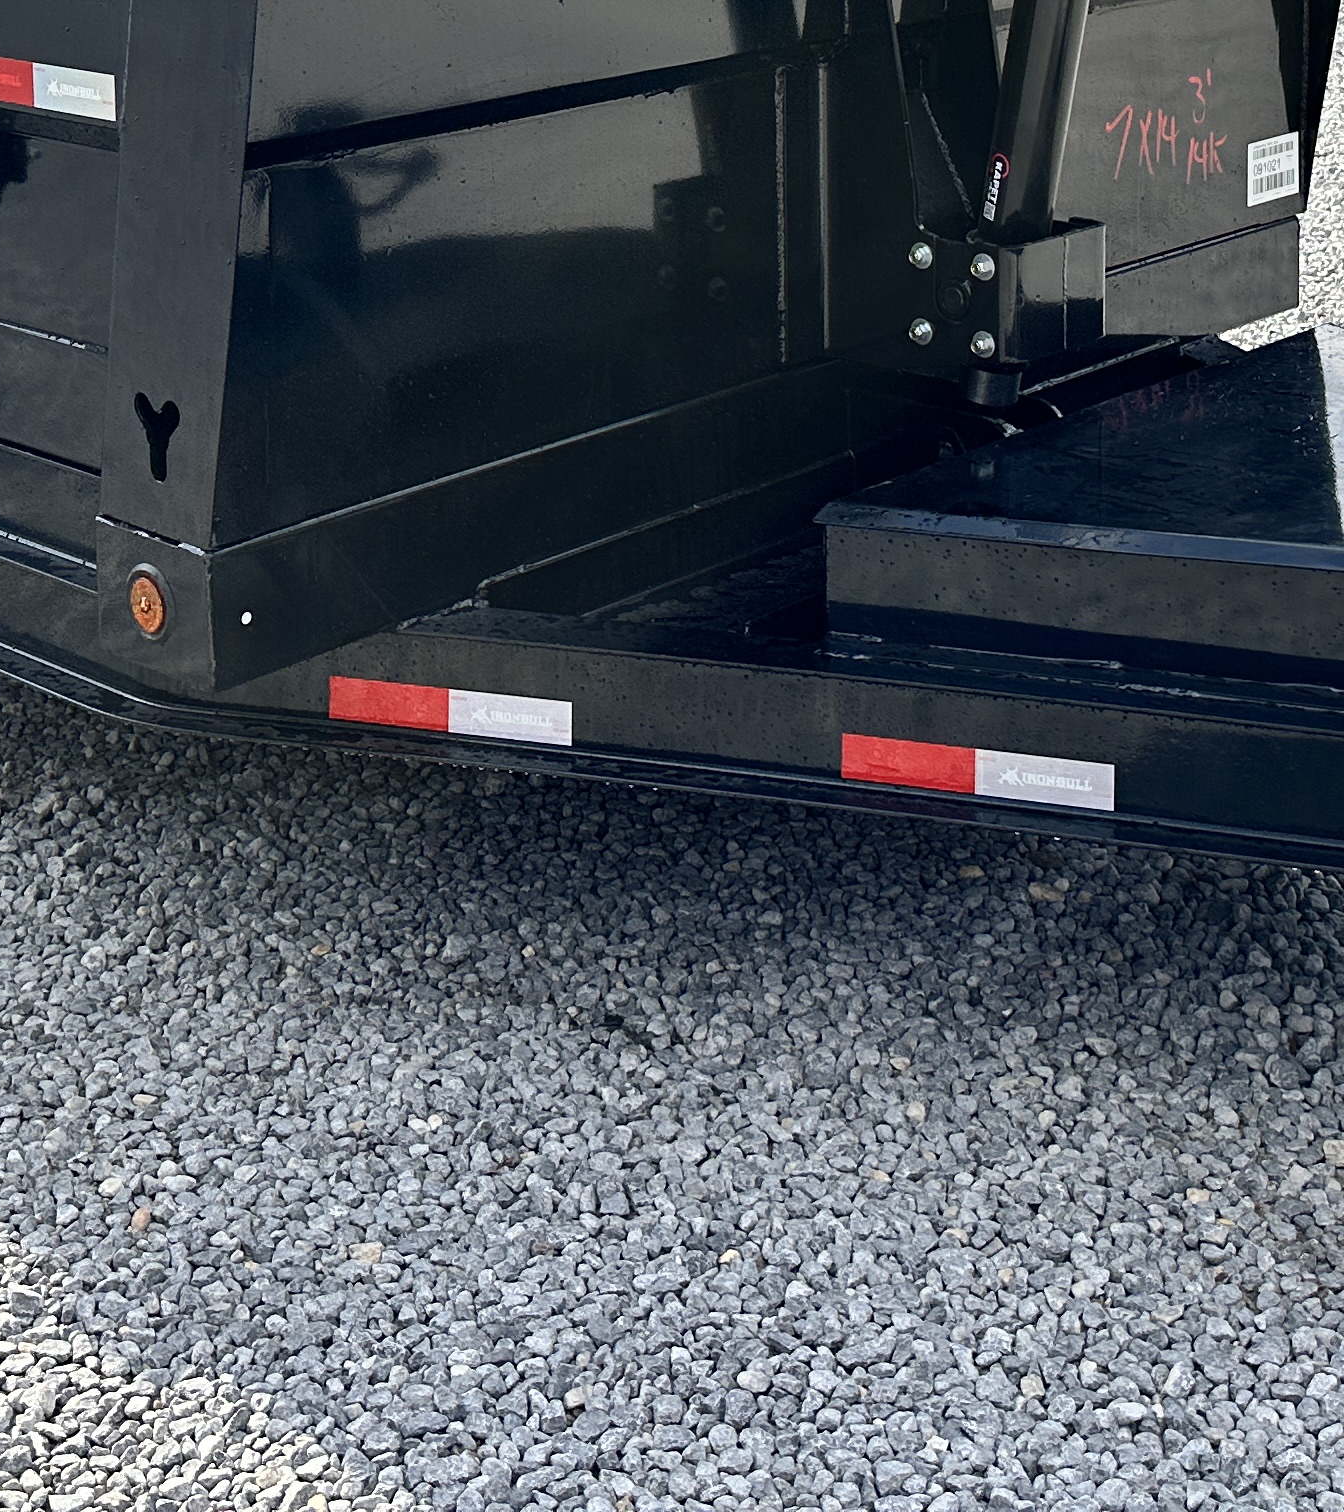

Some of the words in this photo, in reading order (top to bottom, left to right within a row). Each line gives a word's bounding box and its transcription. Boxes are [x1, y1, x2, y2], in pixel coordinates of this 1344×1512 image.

[60, 83, 102, 101] IRONBULL
[490, 710, 553, 728] IRONBULL
[1021, 772, 1093, 792] IRONBULL
